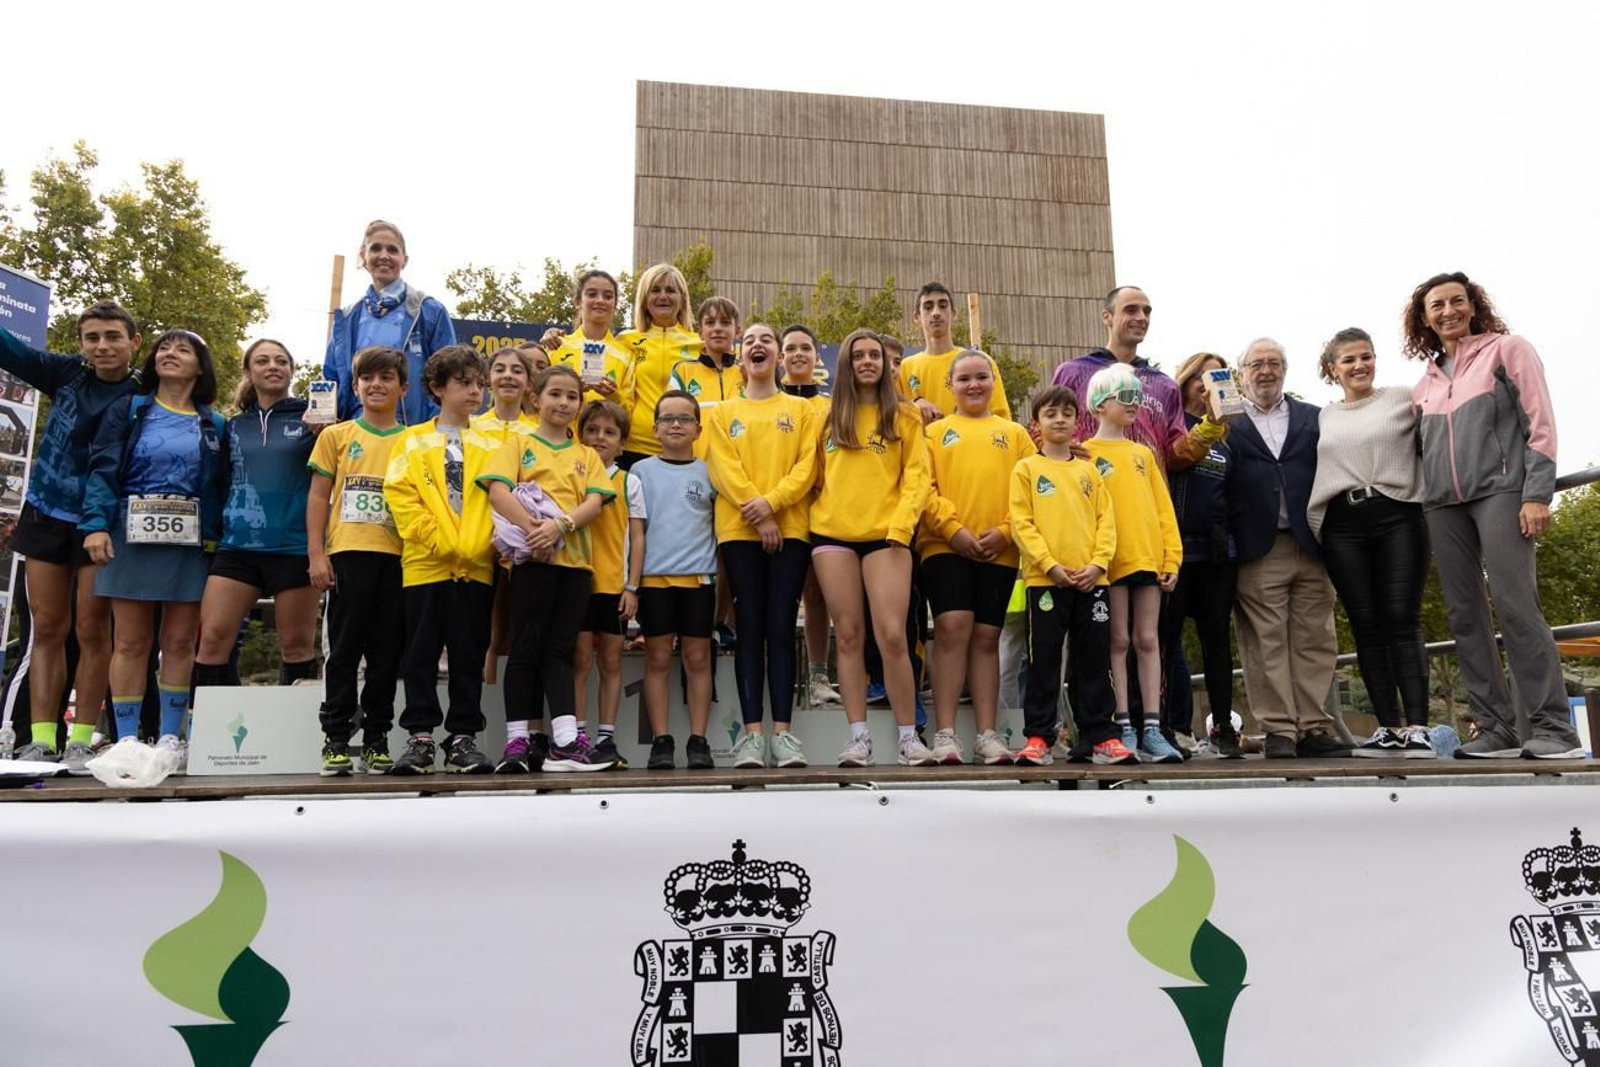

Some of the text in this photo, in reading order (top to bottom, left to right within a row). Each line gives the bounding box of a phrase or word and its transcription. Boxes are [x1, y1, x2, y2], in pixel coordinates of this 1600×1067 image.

[583, 342, 605, 354] XXV
[310, 382, 336, 393] XXV
[143, 516, 184, 533] 356
[1518, 922, 1528, 938] MUY
[646, 948, 658, 998] MUY NOBLE
[813, 941, 837, 1044] REYNOS DE CASTILLA
[638, 1018, 650, 1038] MUY
[635, 1038, 644, 1060] LEAL
[1553, 1025, 1571, 1056] CIUDAD
